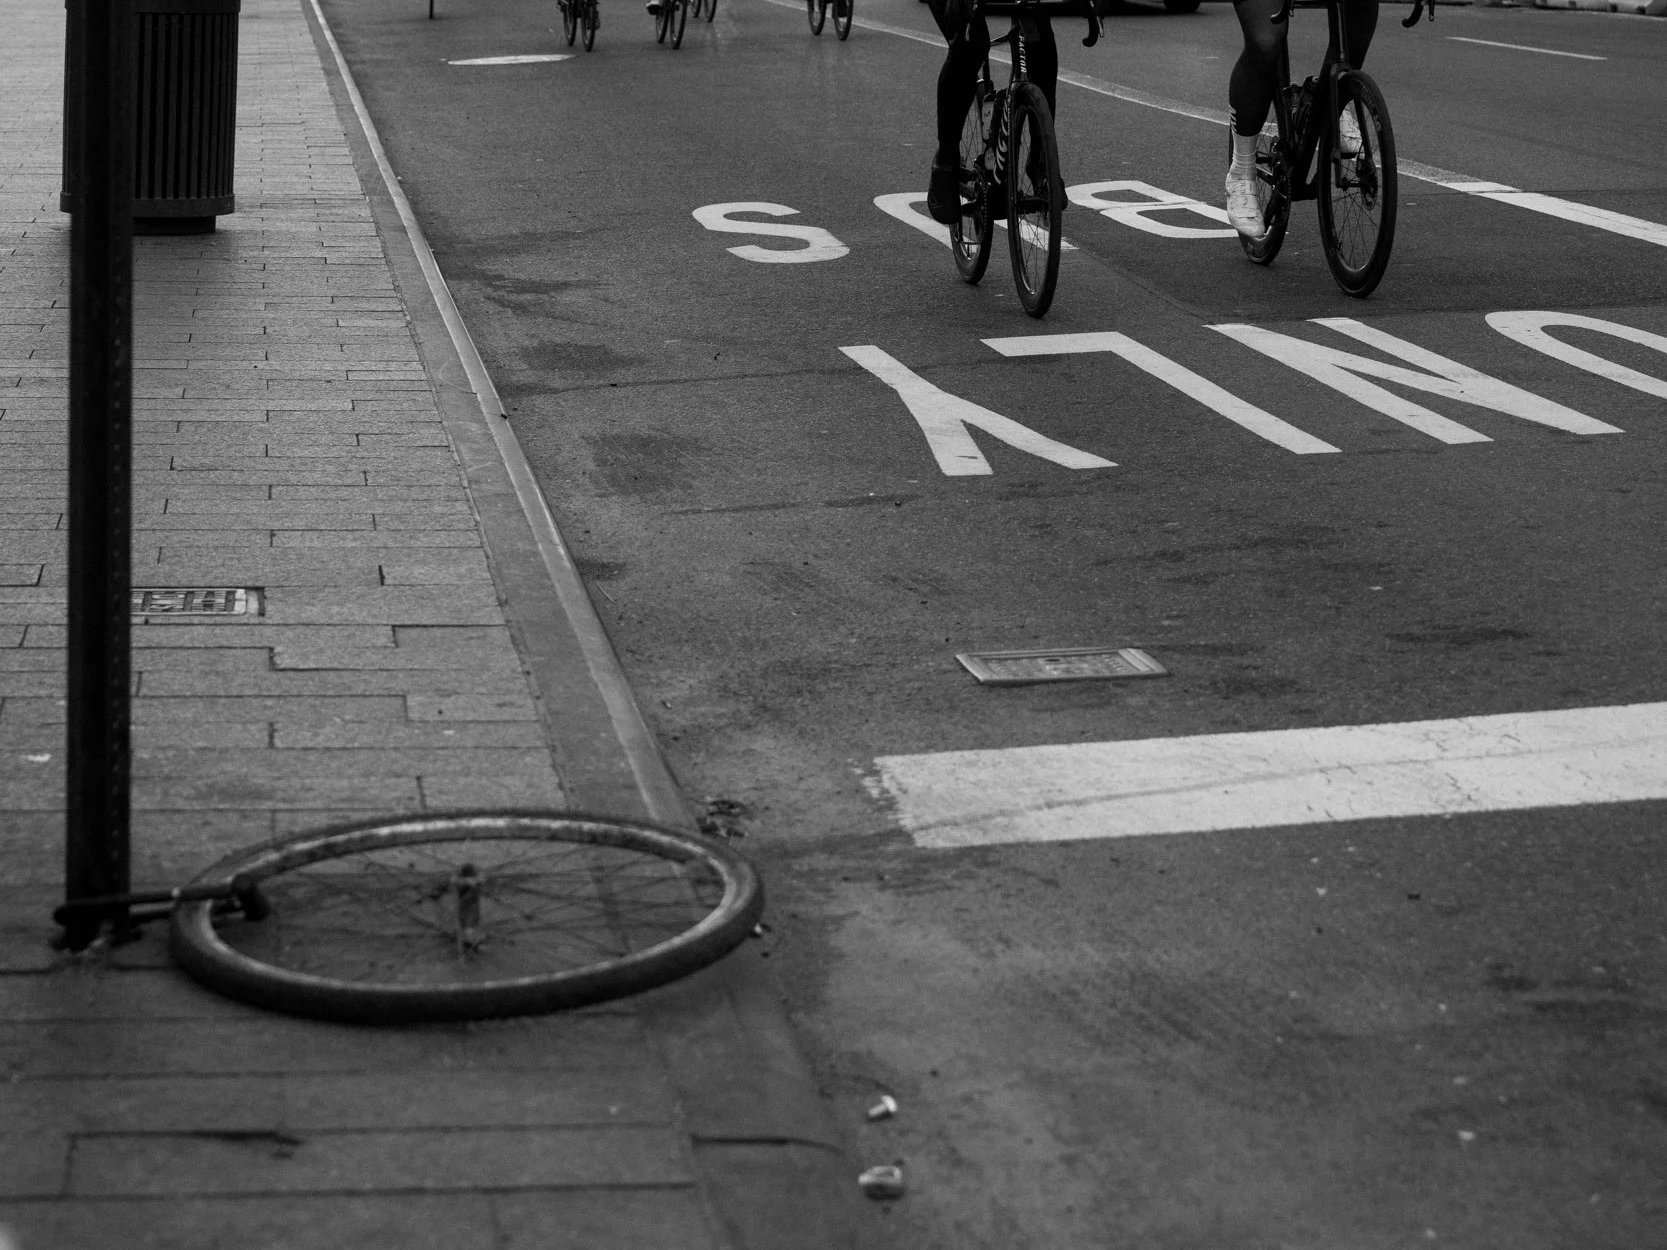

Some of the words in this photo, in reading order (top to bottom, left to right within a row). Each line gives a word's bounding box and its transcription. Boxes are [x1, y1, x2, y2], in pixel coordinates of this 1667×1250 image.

[1018, 34, 1027, 74] FACTOR
[691, 179, 1243, 263] BUS
[838, 310, 1667, 476] ONLY
